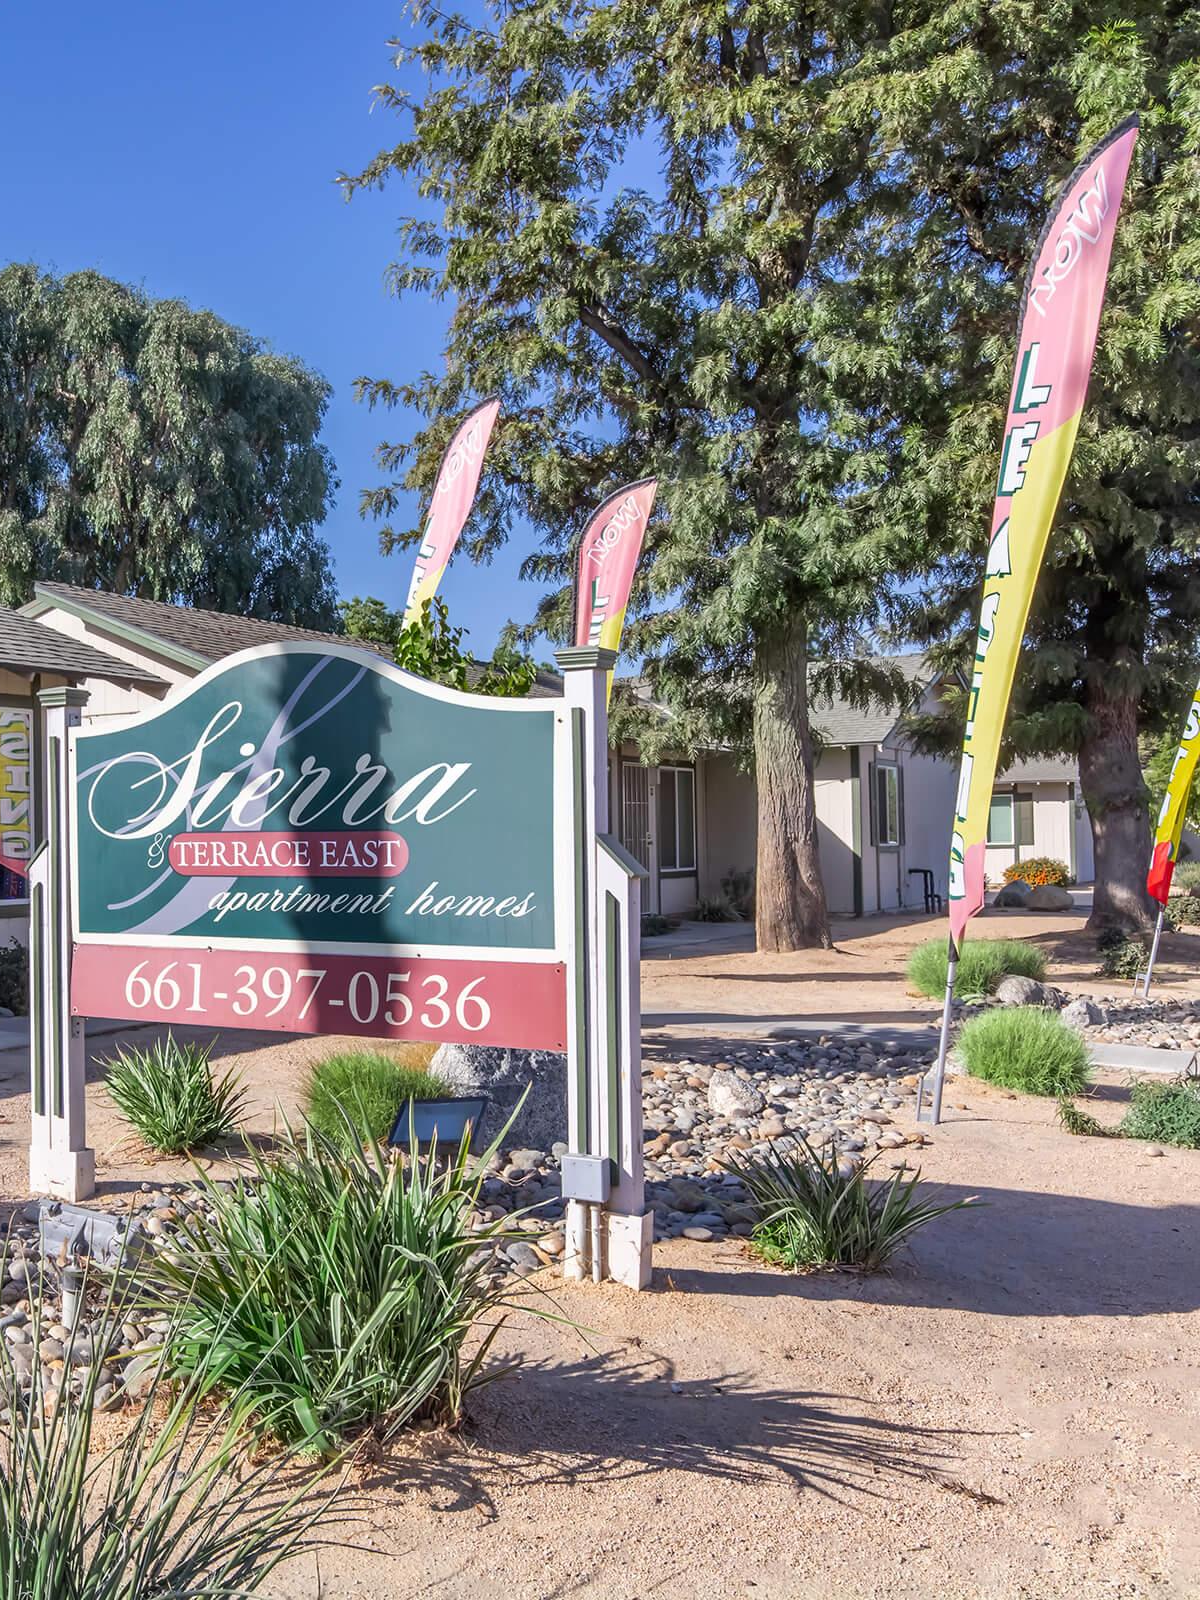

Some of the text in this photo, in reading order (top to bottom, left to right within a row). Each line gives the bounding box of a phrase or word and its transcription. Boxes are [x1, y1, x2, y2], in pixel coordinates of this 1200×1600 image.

[1030, 167, 1110, 317] NOW
[587, 495, 642, 565] NOW
[88, 701, 477, 839] Sierra
[147, 833, 400, 868] & TERRACE EAST
[208, 881, 536, 922] apartment homes
[125, 960, 491, 1031] 661-397-0536
